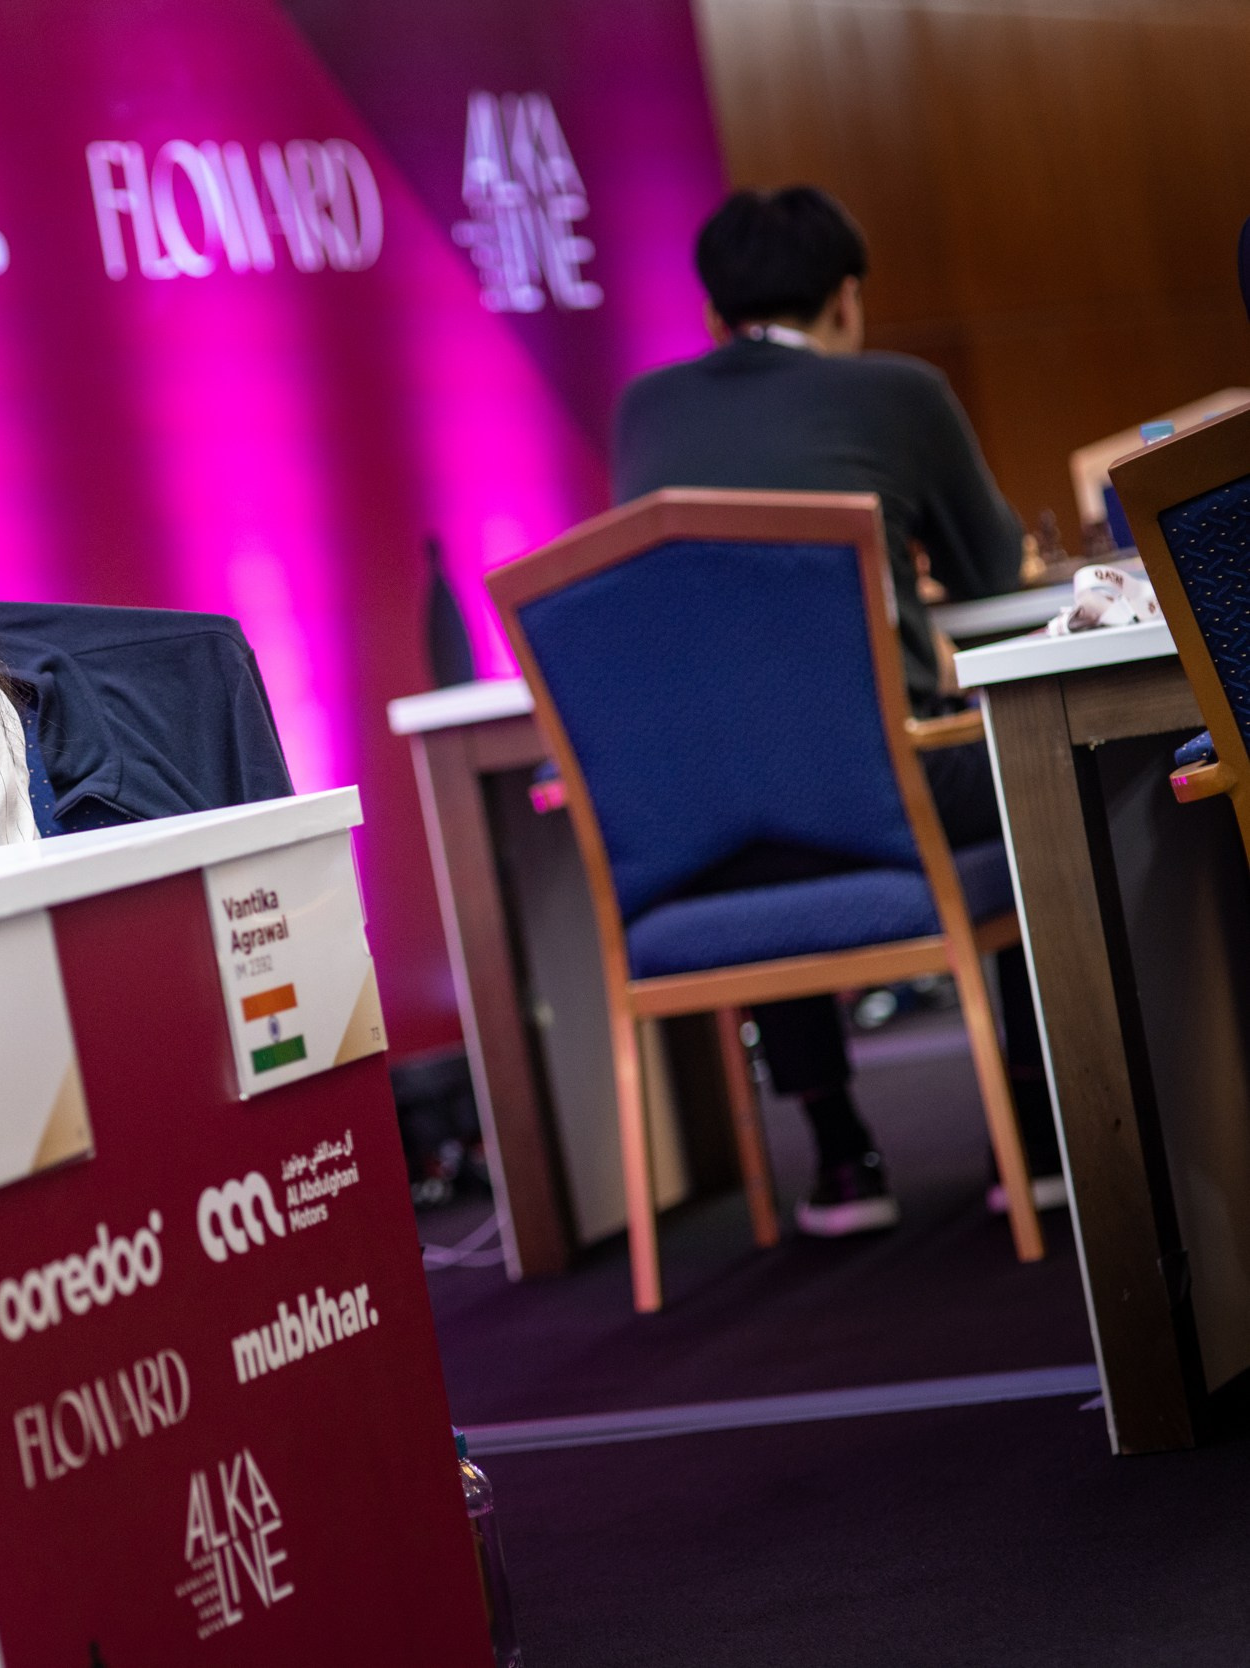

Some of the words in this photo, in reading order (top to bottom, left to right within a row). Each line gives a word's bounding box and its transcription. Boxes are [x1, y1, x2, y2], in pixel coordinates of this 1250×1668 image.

[222, 887, 280, 921] Vantika
[231, 915, 290, 955] Agrawal
[286, 1184, 300, 1209] Al
[300, 1160, 359, 1205] Abdulghani
[288, 1203, 329, 1233] Motors
[232, 1283, 379, 1384] mubkhar.
[184, 1446, 282, 1561] ALKA
